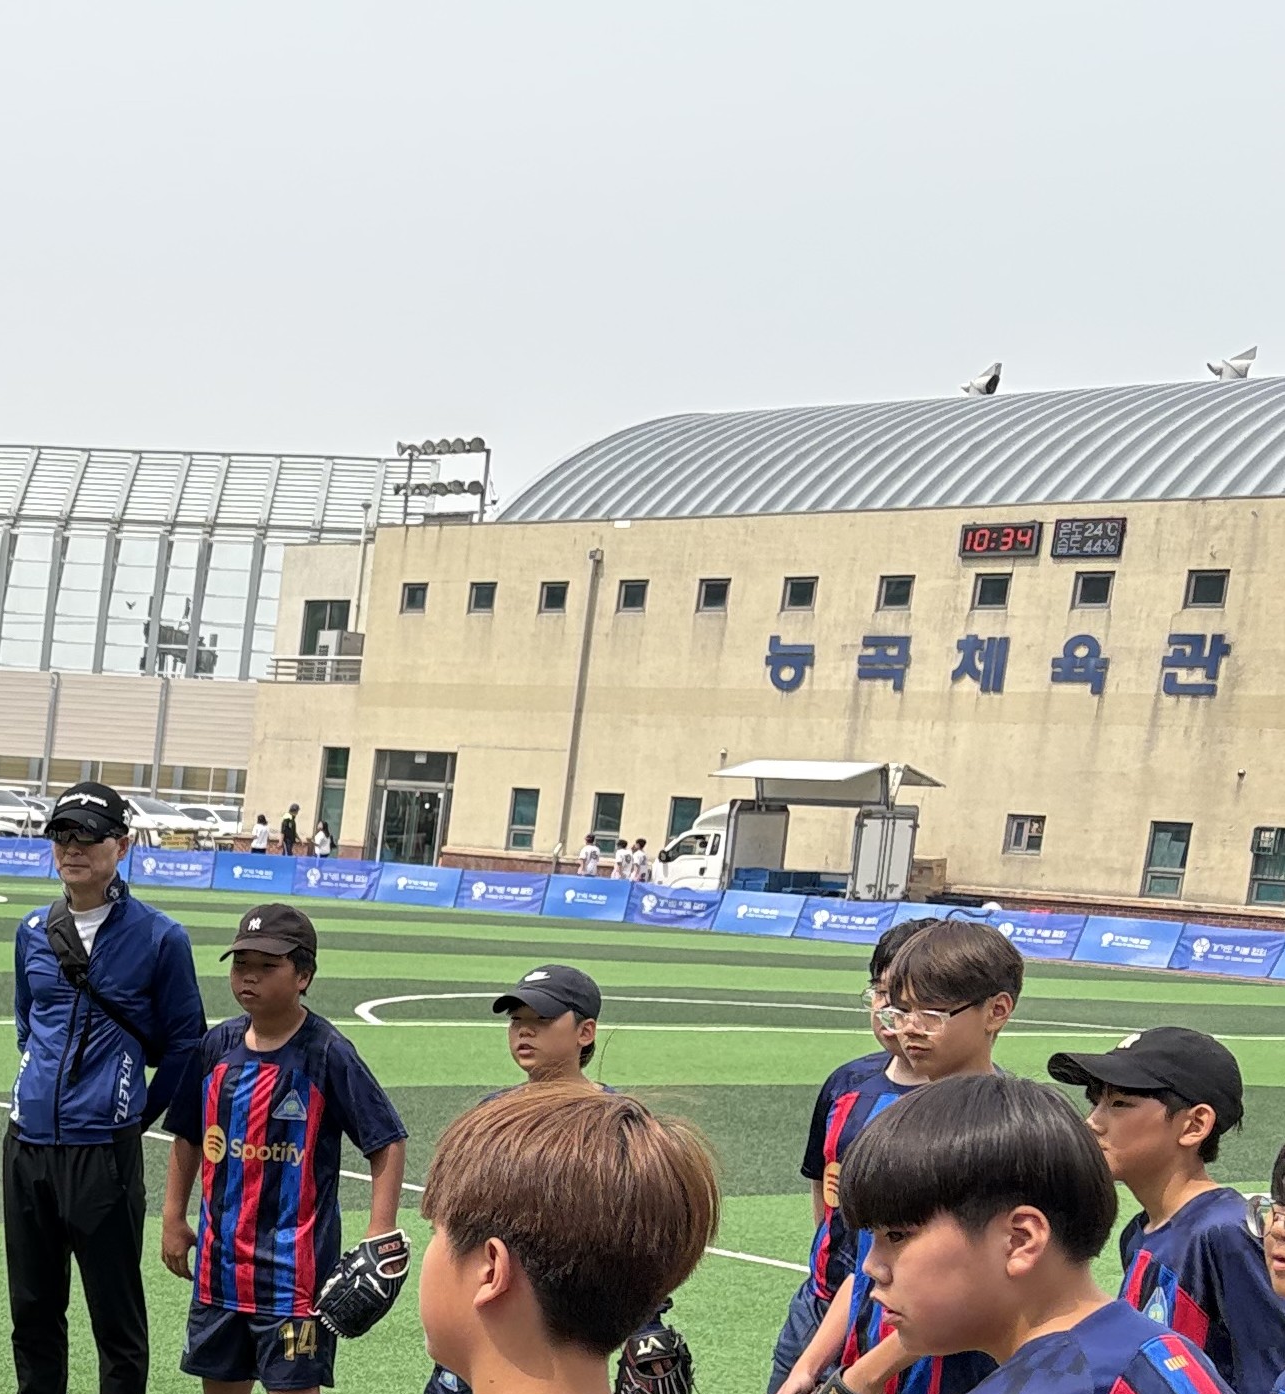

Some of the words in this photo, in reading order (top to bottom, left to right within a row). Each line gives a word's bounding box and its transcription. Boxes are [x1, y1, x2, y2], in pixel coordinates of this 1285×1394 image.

[964, 527, 1033, 552] 10:34
[1059, 522, 1084, 538] 온도
[1057, 538, 1083, 553] 습도
[1083, 538, 1116, 553] 44%
[765, 633, 1232, 697] 능곡체육관
[229, 1138, 306, 1167] Spotify
[279, 1320, 318, 1362] 14
